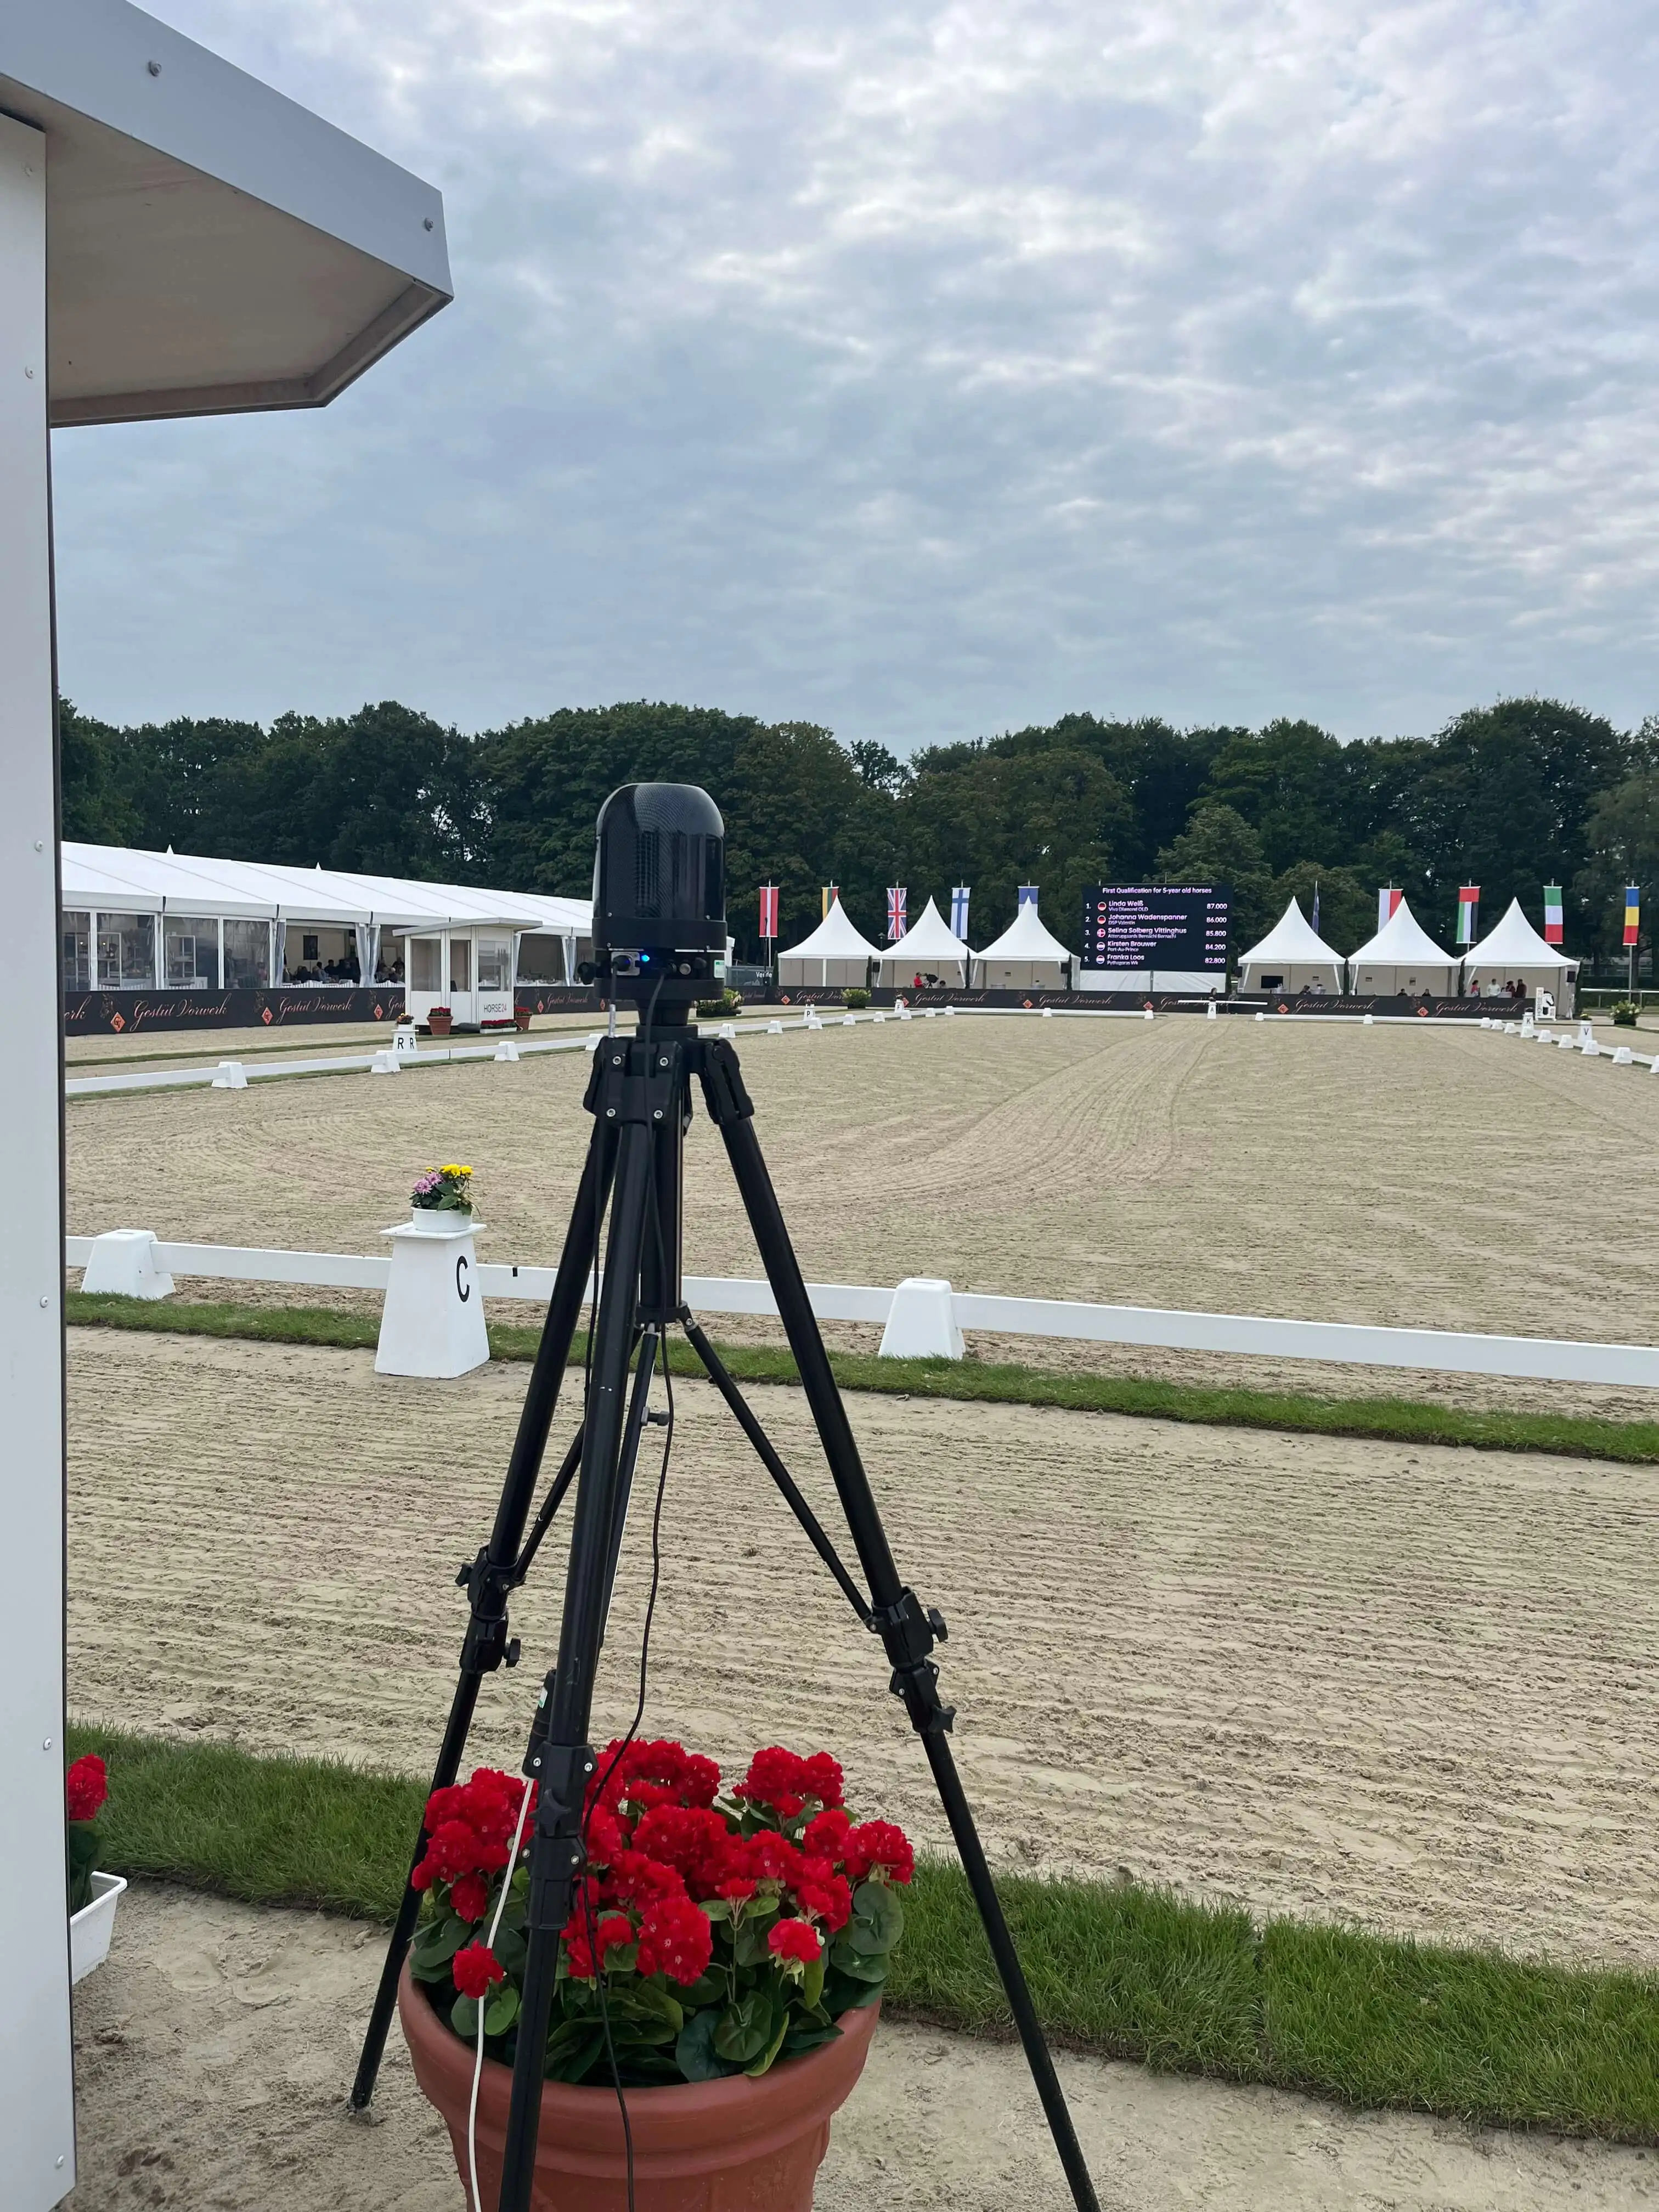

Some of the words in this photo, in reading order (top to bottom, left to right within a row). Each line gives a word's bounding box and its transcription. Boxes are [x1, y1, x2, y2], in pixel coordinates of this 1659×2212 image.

[311, 991, 357, 1013] Vorwerk
[484, 1004, 507, 1013] HORSE24
[129, 1000, 175, 1032] Gestüt
[176, 993, 232, 1018] Vorwerk
[398, 1037, 404, 1049] R
[409, 1037, 415, 1049] R
[456, 1255, 470, 1302] C
